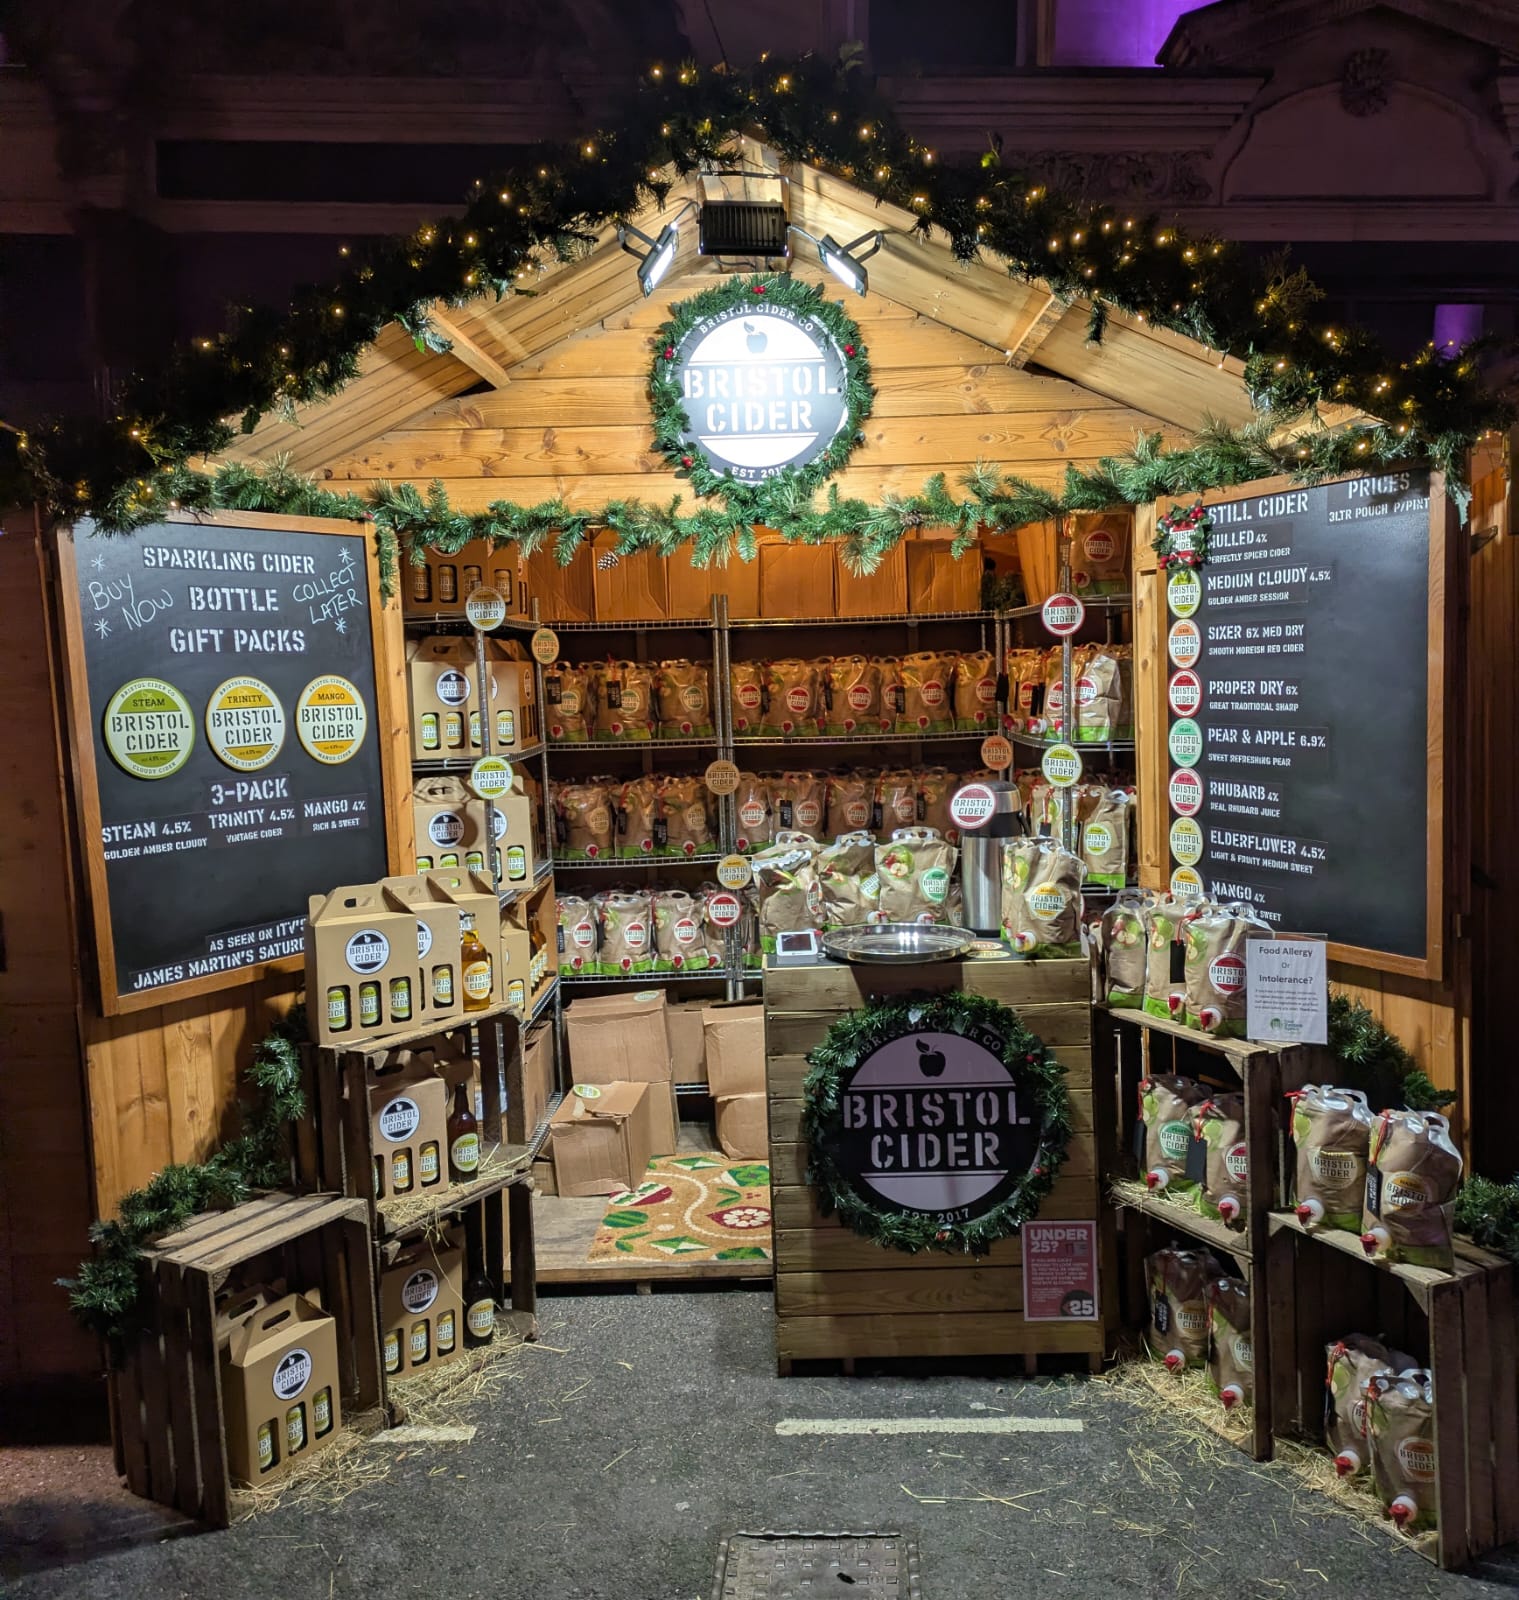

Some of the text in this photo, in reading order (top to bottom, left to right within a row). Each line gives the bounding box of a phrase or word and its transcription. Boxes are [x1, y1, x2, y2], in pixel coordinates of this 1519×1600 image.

[701, 304, 813, 333] BRISTOL CIDER CO
[684, 366, 837, 398] BRISTOL
[706, 400, 812, 432] CIDER
[732, 466, 755, 478] EST
[1349, 472, 1410, 499] PRICES
[1208, 492, 1308, 524] STILL CIDER
[1329, 497, 1430, 522] 3LTR POUCH P/PINT
[1207, 530, 1268, 549] MULLED 4%
[143, 547, 315, 574] SPARKLING CIDER
[1243, 550, 1268, 560] SPICED
[1269, 547, 1290, 557] CIDER
[293, 562, 355, 602] COLLECT
[1208, 567, 1331, 590] MEDIUM CLOUDY 4.5%
[1170, 585, 1199, 595] BRISTOL
[190, 586, 279, 611] BOTTLE
[468, 602, 504, 610] BRISTOL
[1174, 594, 1194, 604] CIDER
[1208, 591, 1289, 606] GOLDEN AMBER SESSION
[310, 589, 363, 624] LATER
[1044, 606, 1080, 616] BRISTOL
[474, 610, 499, 619] CIDER
[1050, 615, 1076, 623] CIDER
[1208, 624, 1304, 640] SIXER 6% MED DRY
[170, 629, 305, 653] GIFT PACKS
[1170, 636, 1199, 646] BRISTOL
[1174, 645, 1194, 655] CIDER
[1208, 643, 1304, 656] SMOOTH MOREISH RED CIDER
[1171, 686, 1199, 696] BRISTOL
[1209, 680, 1298, 696] PROPER DRY 6%
[132, 698, 165, 708] STEAM
[227, 694, 263, 704] TRINITY
[318, 692, 345, 701] MANGO
[1175, 695, 1195, 704] CIDER
[1209, 701, 1298, 712] GREAT TRADITIONAL SHARP
[212, 708, 281, 728] BRISTOL
[301, 707, 363, 723] BRISTOL
[112, 713, 189, 733] BRISTOL
[225, 727, 272, 745] CIDER
[312, 724, 354, 740] CIDER
[1208, 728, 1326, 748] PEAR & APPLE 6.9%
[126, 732, 179, 752] CIDER
[1171, 735, 1200, 746] BRISTOL
[1175, 744, 1196, 754] CIDER
[1044, 758, 1079, 769] BRISTOL
[1208, 753, 1291, 767] SWEET REFRESHING PEAR
[474, 771, 511, 780] BRISTOL
[1049, 768, 1074, 776] CIDER
[480, 779, 505, 788] CIDER
[1171, 784, 1200, 795] BRISTOL
[211, 778, 288, 805] 3-PACK
[1175, 794, 1196, 804] CIDER
[1210, 781, 1279, 802] RHUBARB 4%
[304, 799, 366, 818] MANGO 4%
[953, 798, 993, 808] BRISTOL
[1210, 802, 1280, 818] REAL RHUBARB JUICE
[208, 808, 295, 829] TRINITY 4.5%
[958, 807, 986, 816] CIDER
[101, 820, 192, 843] STEAM 4.5%
[312, 818, 360, 832] RICH & SWEET
[226, 827, 283, 844] VINTAGE CIDER
[1171, 834, 1200, 844] BRISTOL
[104, 838, 207, 860] GOLDEN AMBER CLOUDY
[1176, 843, 1196, 852] CIDER
[1210, 829, 1326, 860] ELDERFLOWER 4.5%
[1210, 851, 1314, 874] LIGHT & FRUITY MEDIUM SWEET
[1211, 880, 1266, 903] MANGO 4%
[1260, 911, 1282, 922] SWEET
[210, 938, 224, 952] AS
[228, 932, 255, 948] SEEN
[259, 928, 273, 941] ON
[349, 943, 388, 955] BRISTOL
[1259, 946, 1313, 958] Food Allergy
[355, 952, 382, 962] CIDER
[134, 965, 183, 989] JAMES
[189, 949, 254, 977] MARTIN'S
[1259, 975, 1313, 984] Intolerance?
[983, 1035, 1001, 1051] CO
[843, 1091, 1030, 1128] BRISTOL
[382, 1110, 417, 1125] BRISTOL
[387, 1119, 412, 1132] CIDER
[871, 1132, 999, 1168] CIDER
[1314, 1157, 1356, 1169] BRISTOL
[1320, 1167, 1350, 1177] CIDER
[901, 1208, 970, 1224] EST 2017
[1030, 1228, 1088, 1241] UNDER
[1030, 1241, 1059, 1253] 25?
[1070, 1300, 1093, 1315] 25
[276, 1359, 310, 1384] BRISTOL
[281, 1370, 305, 1389] CIDER
